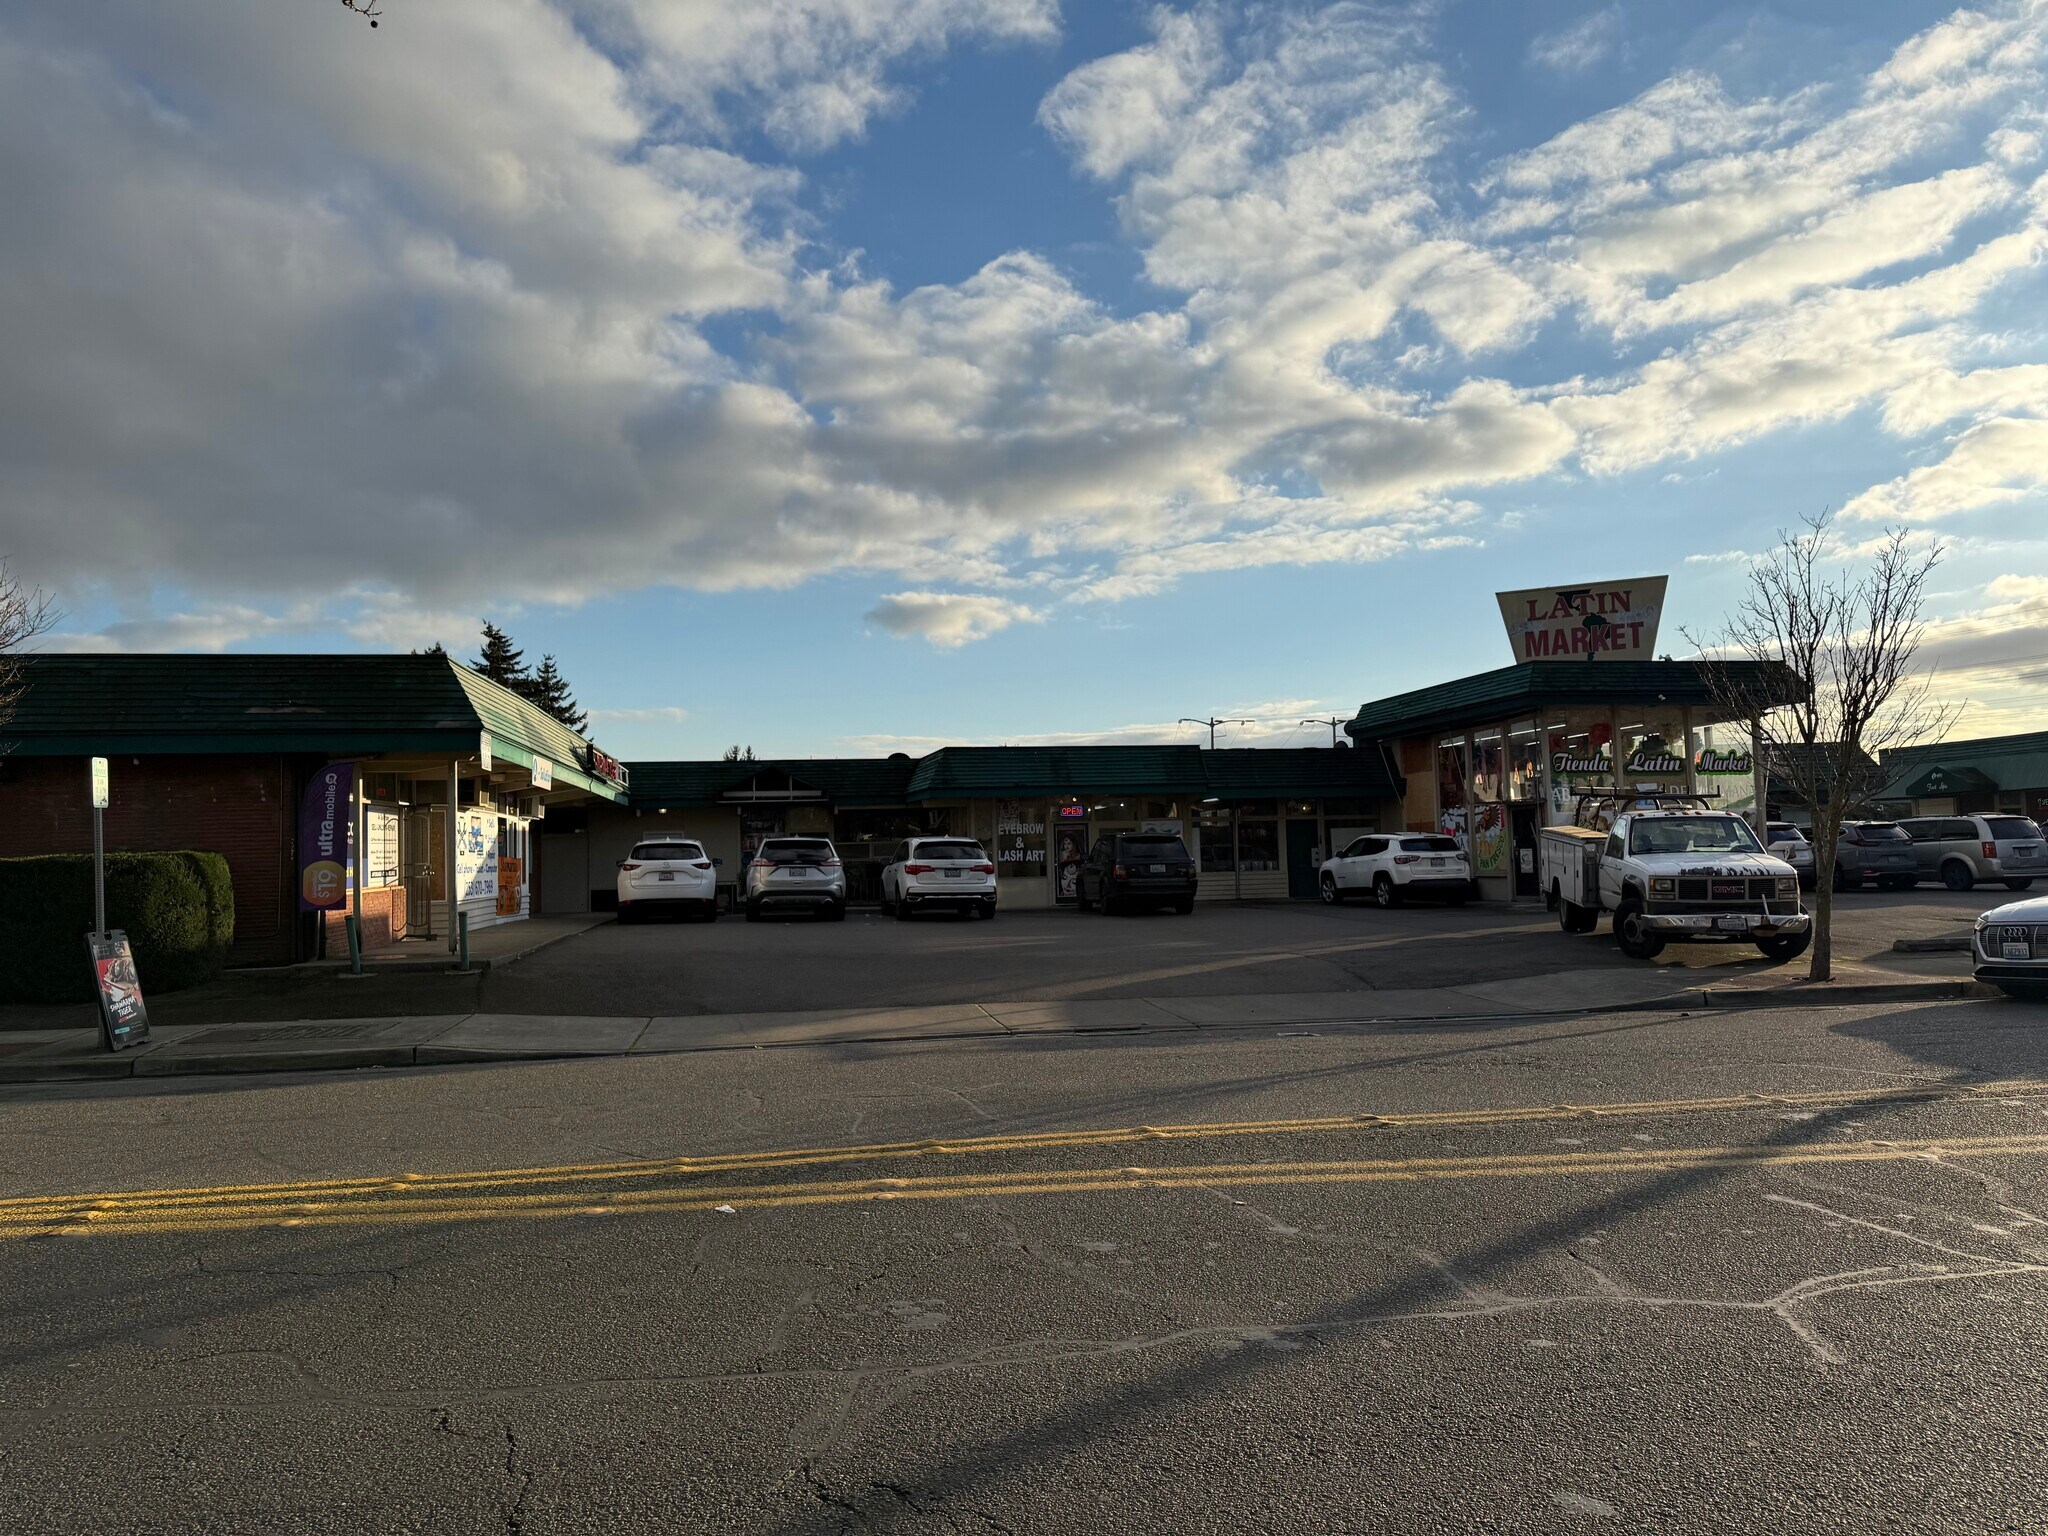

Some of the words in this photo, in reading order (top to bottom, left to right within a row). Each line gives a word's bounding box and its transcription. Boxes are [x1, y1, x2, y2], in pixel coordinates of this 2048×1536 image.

[1526, 590, 1632, 621] LATIN
[1525, 622, 1644, 658] MARKET
[1553, 752, 1609, 773] Tienda
[1627, 752, 1682, 772] Latin
[1698, 749, 1751, 771] Market
[1061, 807, 1082, 815] OPEN
[998, 823, 1044, 835] EYEBROW
[1015, 836, 1024, 848] &
[998, 850, 1024, 861] LASH
[1026, 850, 1045, 861] ART
[1489, 836, 1506, 867] FRESCO
[1712, 885, 1744, 894] GMC
[110, 995, 137, 1012] SHAWARMA
[117, 1005, 133, 1017] TIGER
